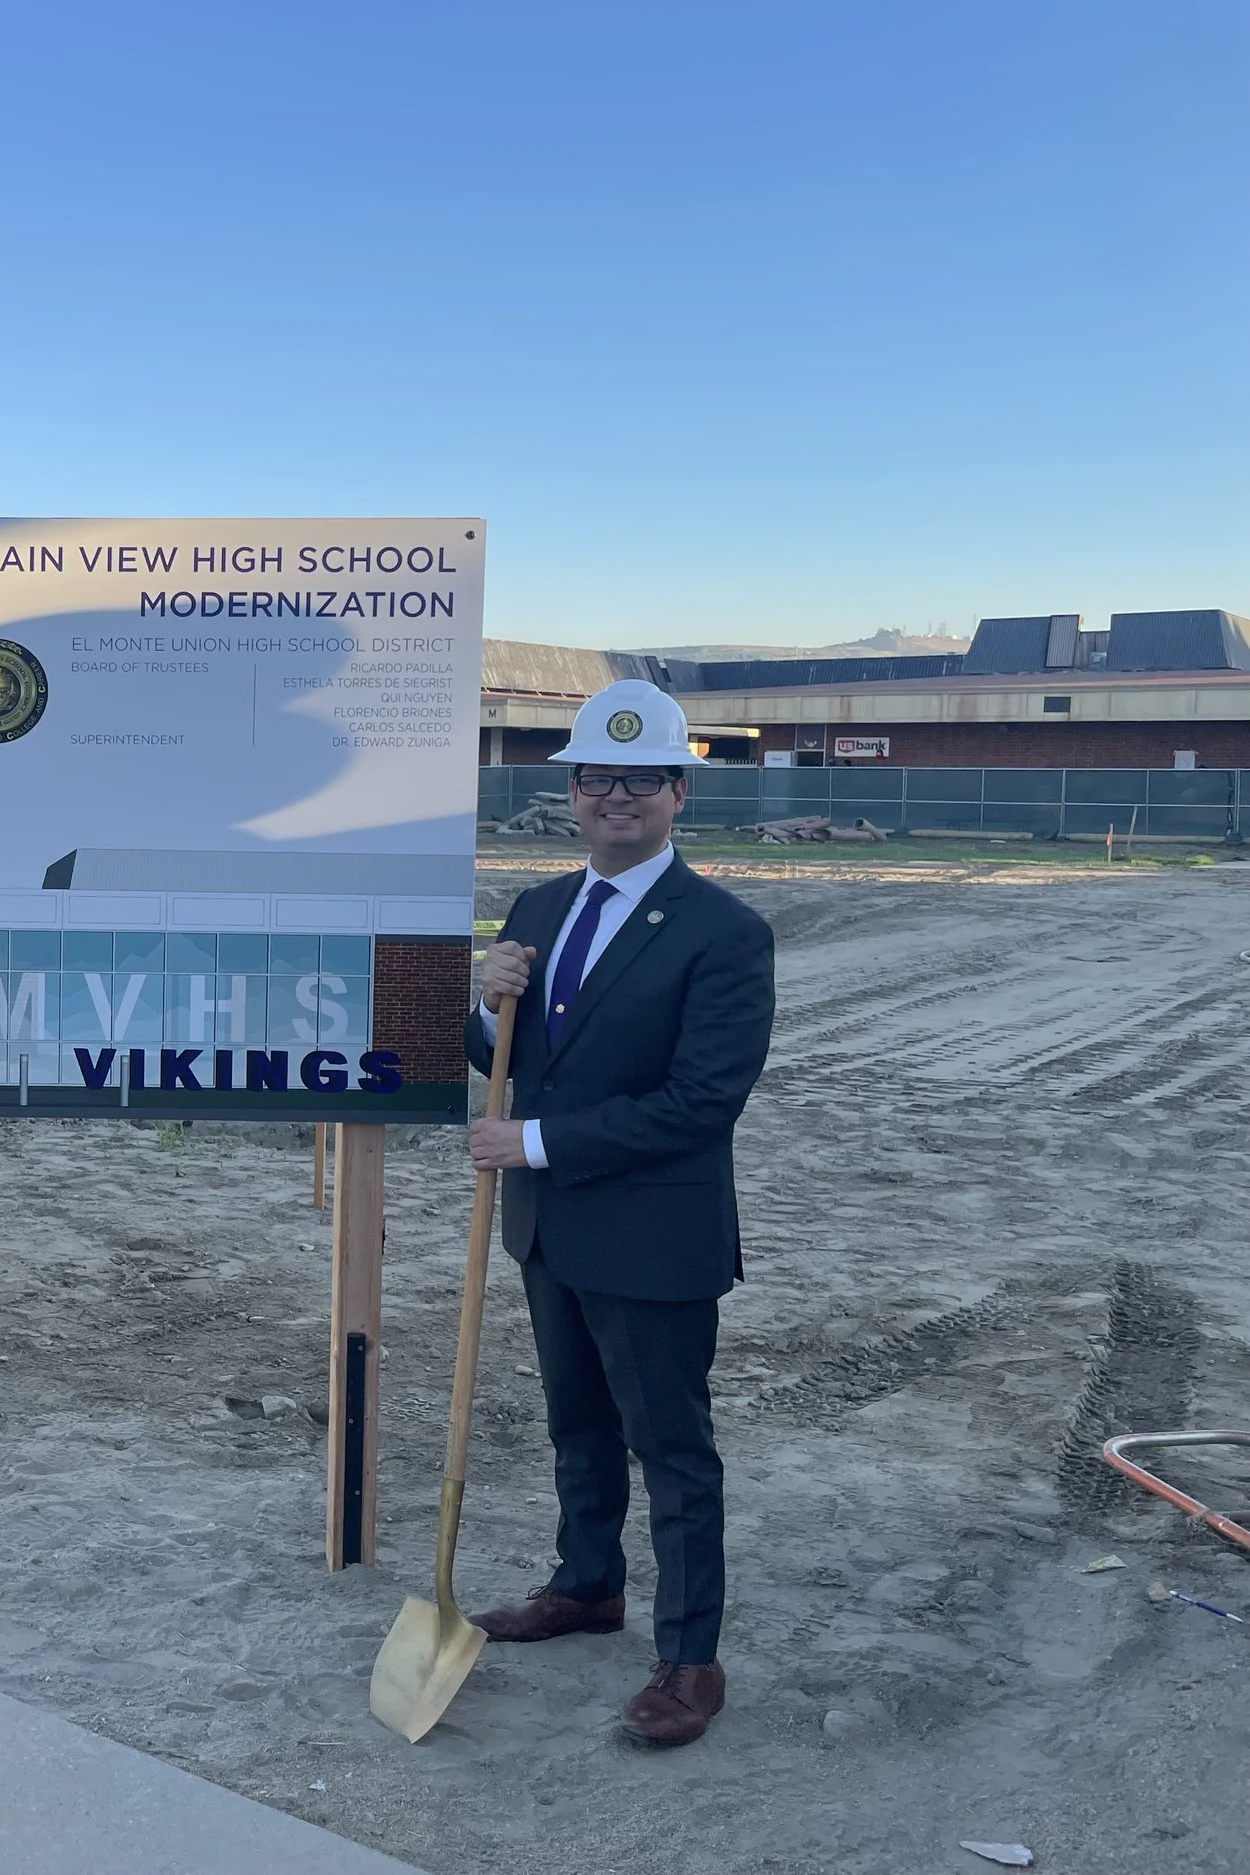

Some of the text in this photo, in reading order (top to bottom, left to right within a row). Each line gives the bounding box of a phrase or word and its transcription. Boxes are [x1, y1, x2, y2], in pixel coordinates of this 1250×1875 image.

[78, 546, 179, 573] VIEW
[193, 546, 283, 573] HIGH
[298, 546, 457, 573] SCHOOL
[140, 591, 454, 618] MODERNIZATION
[72, 637, 455, 652] EL MONTE UNION HIGH SCHOOL DISTRICT
[71, 661, 209, 673] BOARD OF TRUSTEES
[350, 663, 453, 674] RICARDO PADILLA
[283, 677, 453, 688] ESTHELA TORRES DE SIEGRIST
[381, 692, 453, 703] QUI NGUYEN
[334, 707, 452, 718] FLORENCIO BRIONES
[348, 722, 452, 733] CARLOS SALCEDO
[70, 734, 186, 745] SUPERINTENDENT
[332, 737, 451, 747] DR. EDWARD ZUNIGA
[856, 740, 887, 751] bank
[73, 1047, 403, 1095] VIKINGS
